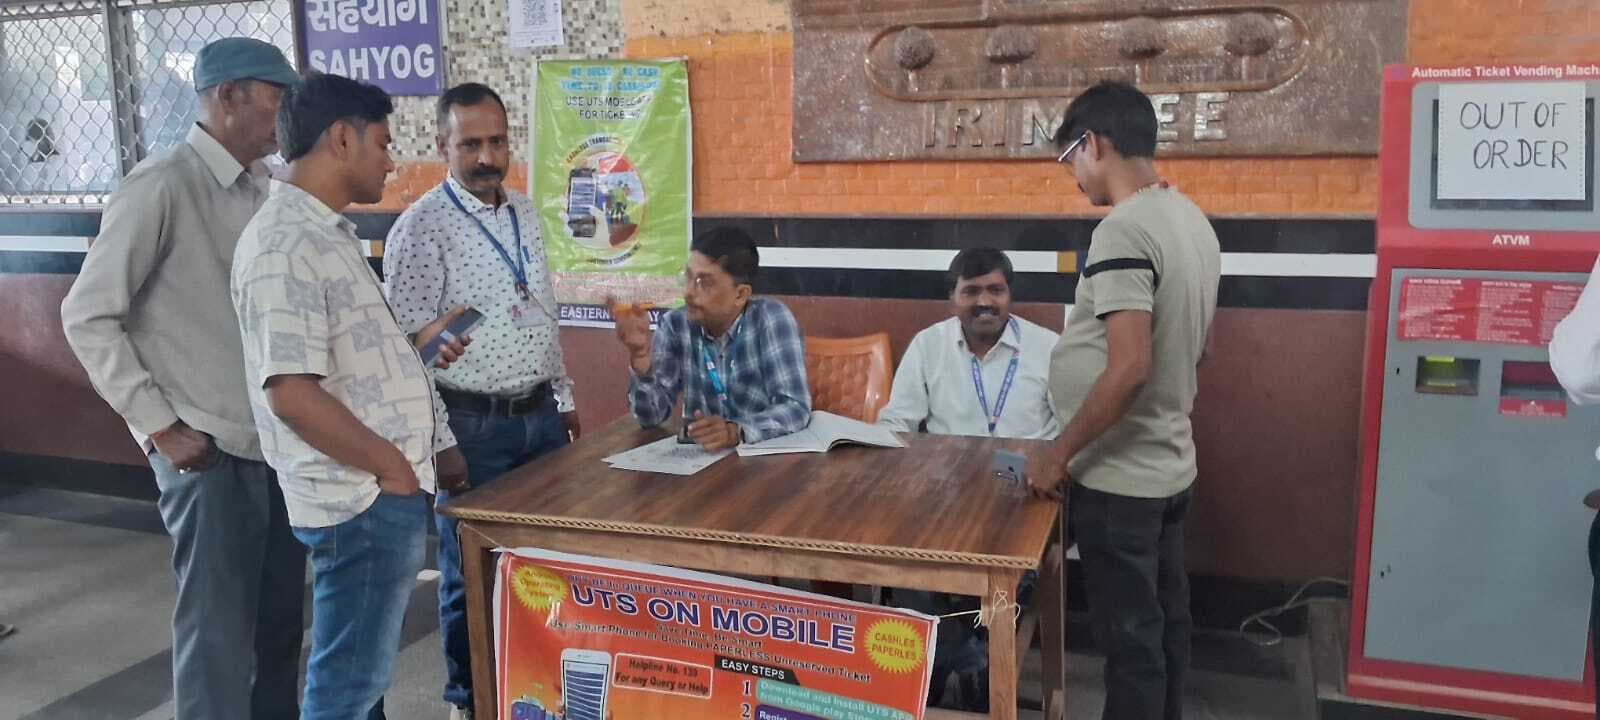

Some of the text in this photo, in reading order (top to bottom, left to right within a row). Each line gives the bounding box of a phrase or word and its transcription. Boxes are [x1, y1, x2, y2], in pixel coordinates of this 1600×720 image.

[309, 43, 436, 81] SAHYOG
[1412, 66, 1472, 77] Automatic
[1475, 66, 1511, 77] Ticket
[1514, 65, 1563, 78] Vending
[565, 96, 585, 107] USE
[586, 96, 603, 107] UTS
[579, 109, 599, 120] FOR
[925, 91, 1230, 147] IRIMEE
[1460, 101, 1567, 130] OUT OF
[1473, 138, 1569, 170] ORDER
[1492, 234, 1531, 247] ATVM
[560, 306, 610, 320] EASTERN
[663, 587, 697, 599] WHEN
[726, 596, 757, 608] HAVE
[760, 601, 769, 610] A
[771, 603, 811, 616] SMART
[570, 583, 858, 655] UTS ON MOBILE
[721, 659, 785, 681] EASY STEPS
[615, 672, 631, 683] For
[631, 675, 648, 687] any
[649, 675, 676, 691] Query
[688, 681, 709, 695] Help
[742, 680, 752, 697] 1
[741, 703, 751, 719] 2
